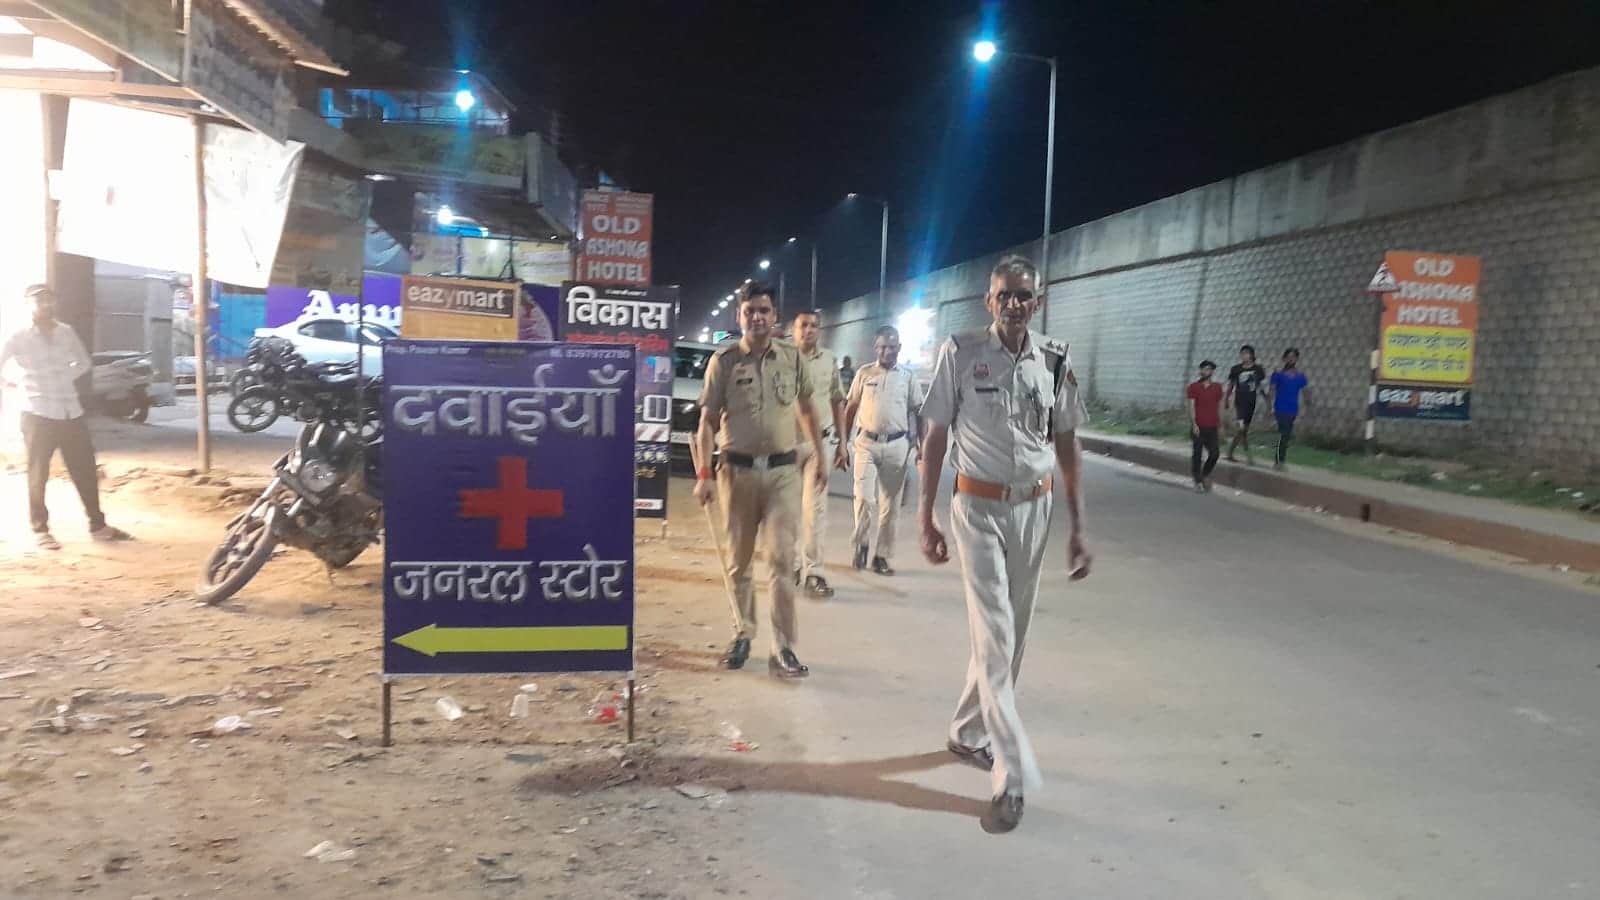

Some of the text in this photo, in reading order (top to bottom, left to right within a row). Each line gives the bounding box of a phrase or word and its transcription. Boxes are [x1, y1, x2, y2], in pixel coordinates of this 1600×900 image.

[592, 214, 641, 234] OLD
[586, 239, 649, 259] ASHOKA
[587, 261, 647, 281] HOTEL
[1414, 257, 1455, 277] OLD
[407, 285, 506, 309] eazymart
[566, 285, 672, 329] विकास
[1397, 306, 1462, 325] HOTEL
[389, 363, 630, 443] दवाईयाँ
[390, 544, 628, 602] जनरल स्टोर
